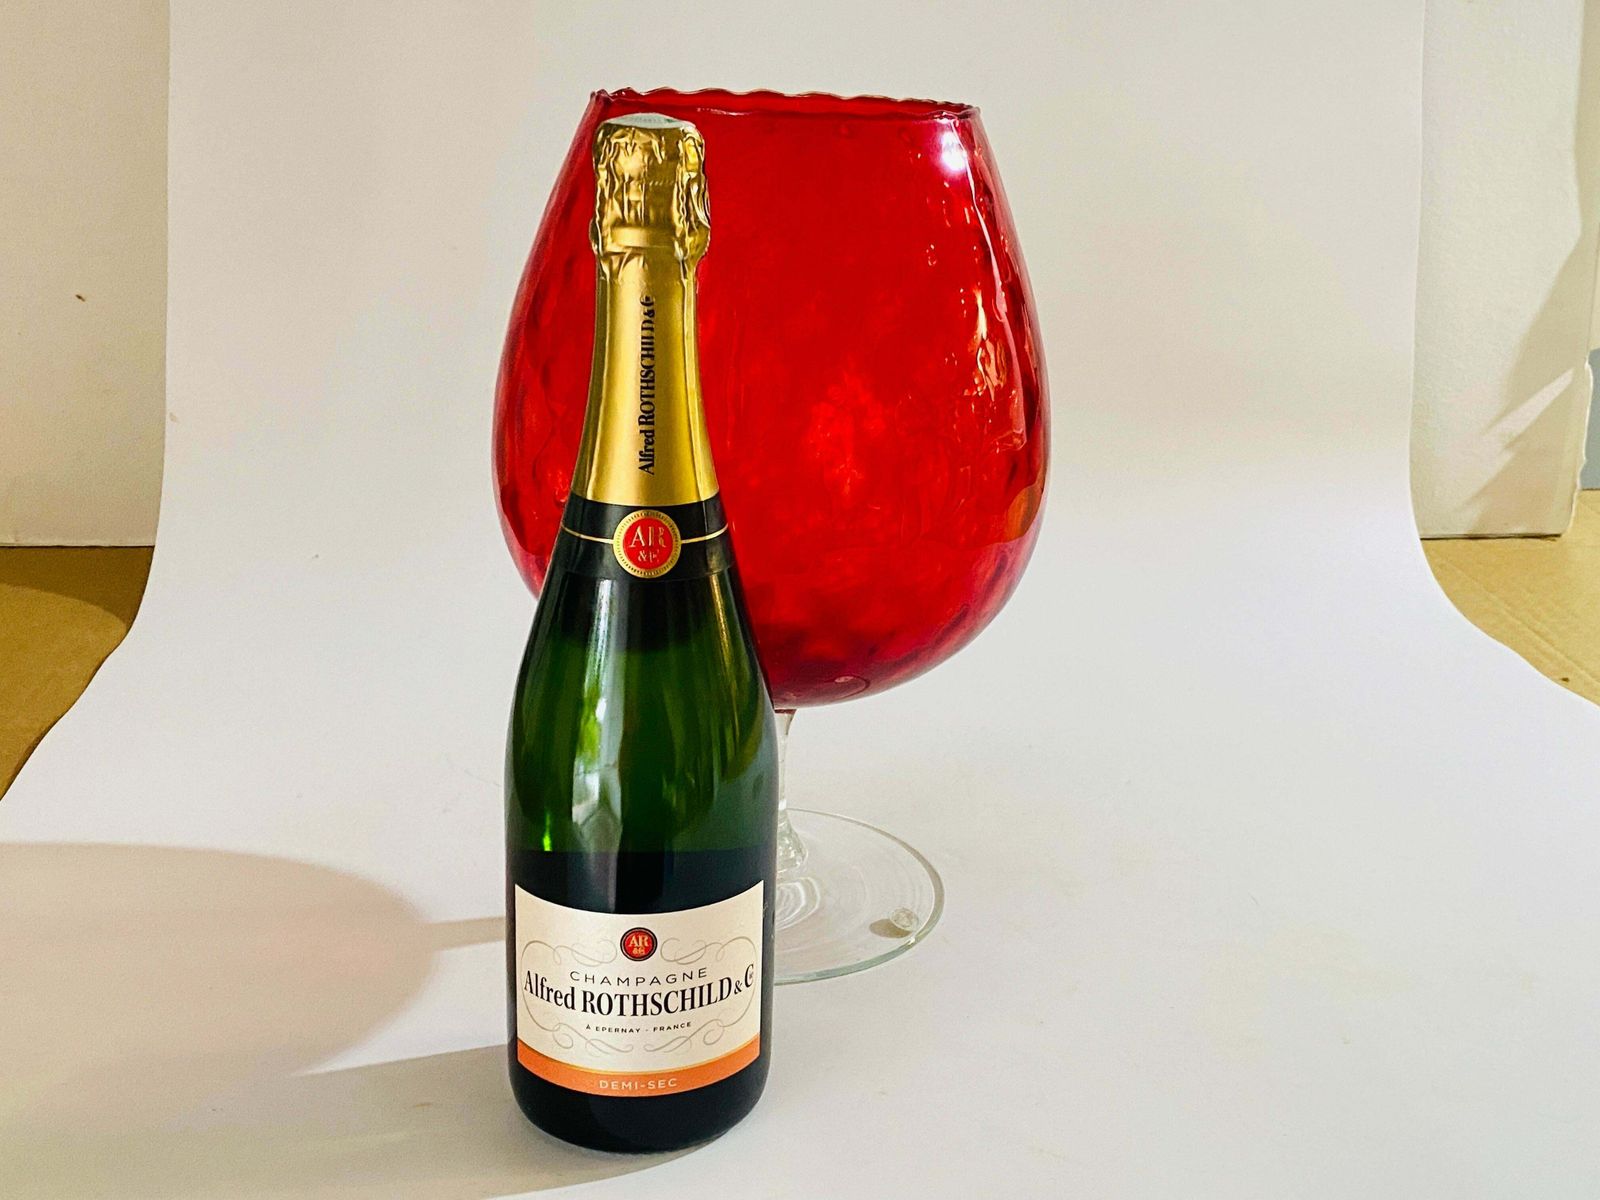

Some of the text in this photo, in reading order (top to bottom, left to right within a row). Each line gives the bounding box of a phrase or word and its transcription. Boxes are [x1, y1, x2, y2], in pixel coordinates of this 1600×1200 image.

[638, 320, 656, 426] ROTHSCHILD
[638, 429, 655, 475] Alfred
[629, 525, 666, 547] AR
[628, 935, 649, 947] AR
[569, 967, 708, 987] CHAMPAGNE
[524, 970, 576, 1011] Alfred
[581, 976, 732, 1017] ROTHSCHILD
[595, 1026, 641, 1034] EPERNAY
[653, 1021, 692, 1033] FRANCE
[599, 1078, 678, 1090] DEMI-SEC
